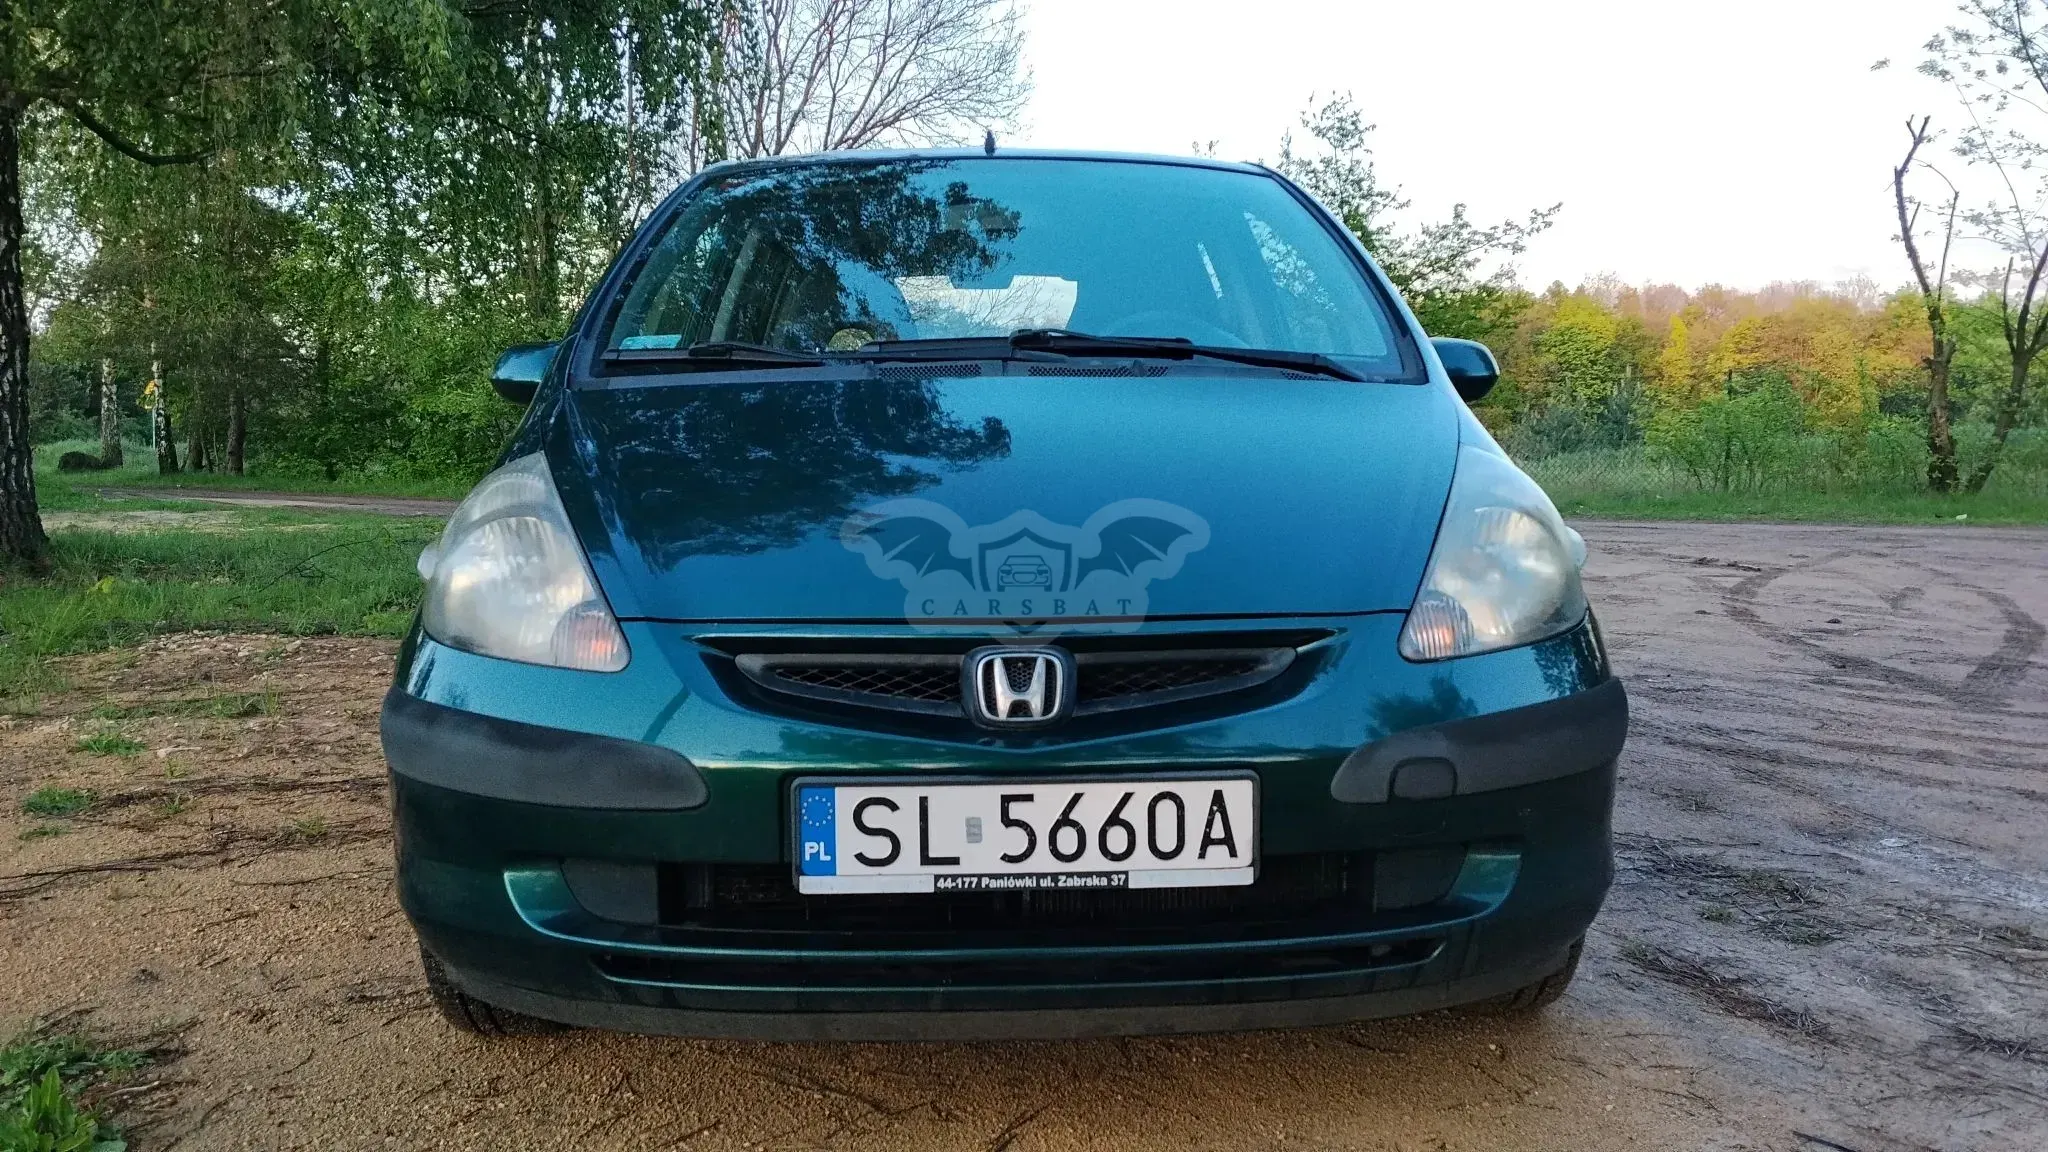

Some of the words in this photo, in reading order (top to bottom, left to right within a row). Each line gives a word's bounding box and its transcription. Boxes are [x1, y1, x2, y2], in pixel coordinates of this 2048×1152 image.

[851, 796, 961, 868] SL
[999, 789, 1239, 864] 5660A
[804, 841, 831, 862] PL
[936, 876, 977, 889] 44-177
[981, 875, 1036, 888] Paniówki
[1040, 875, 1055, 888] ul.
[1058, 874, 1107, 887] Zabrska
[1111, 873, 1126, 886] 37
